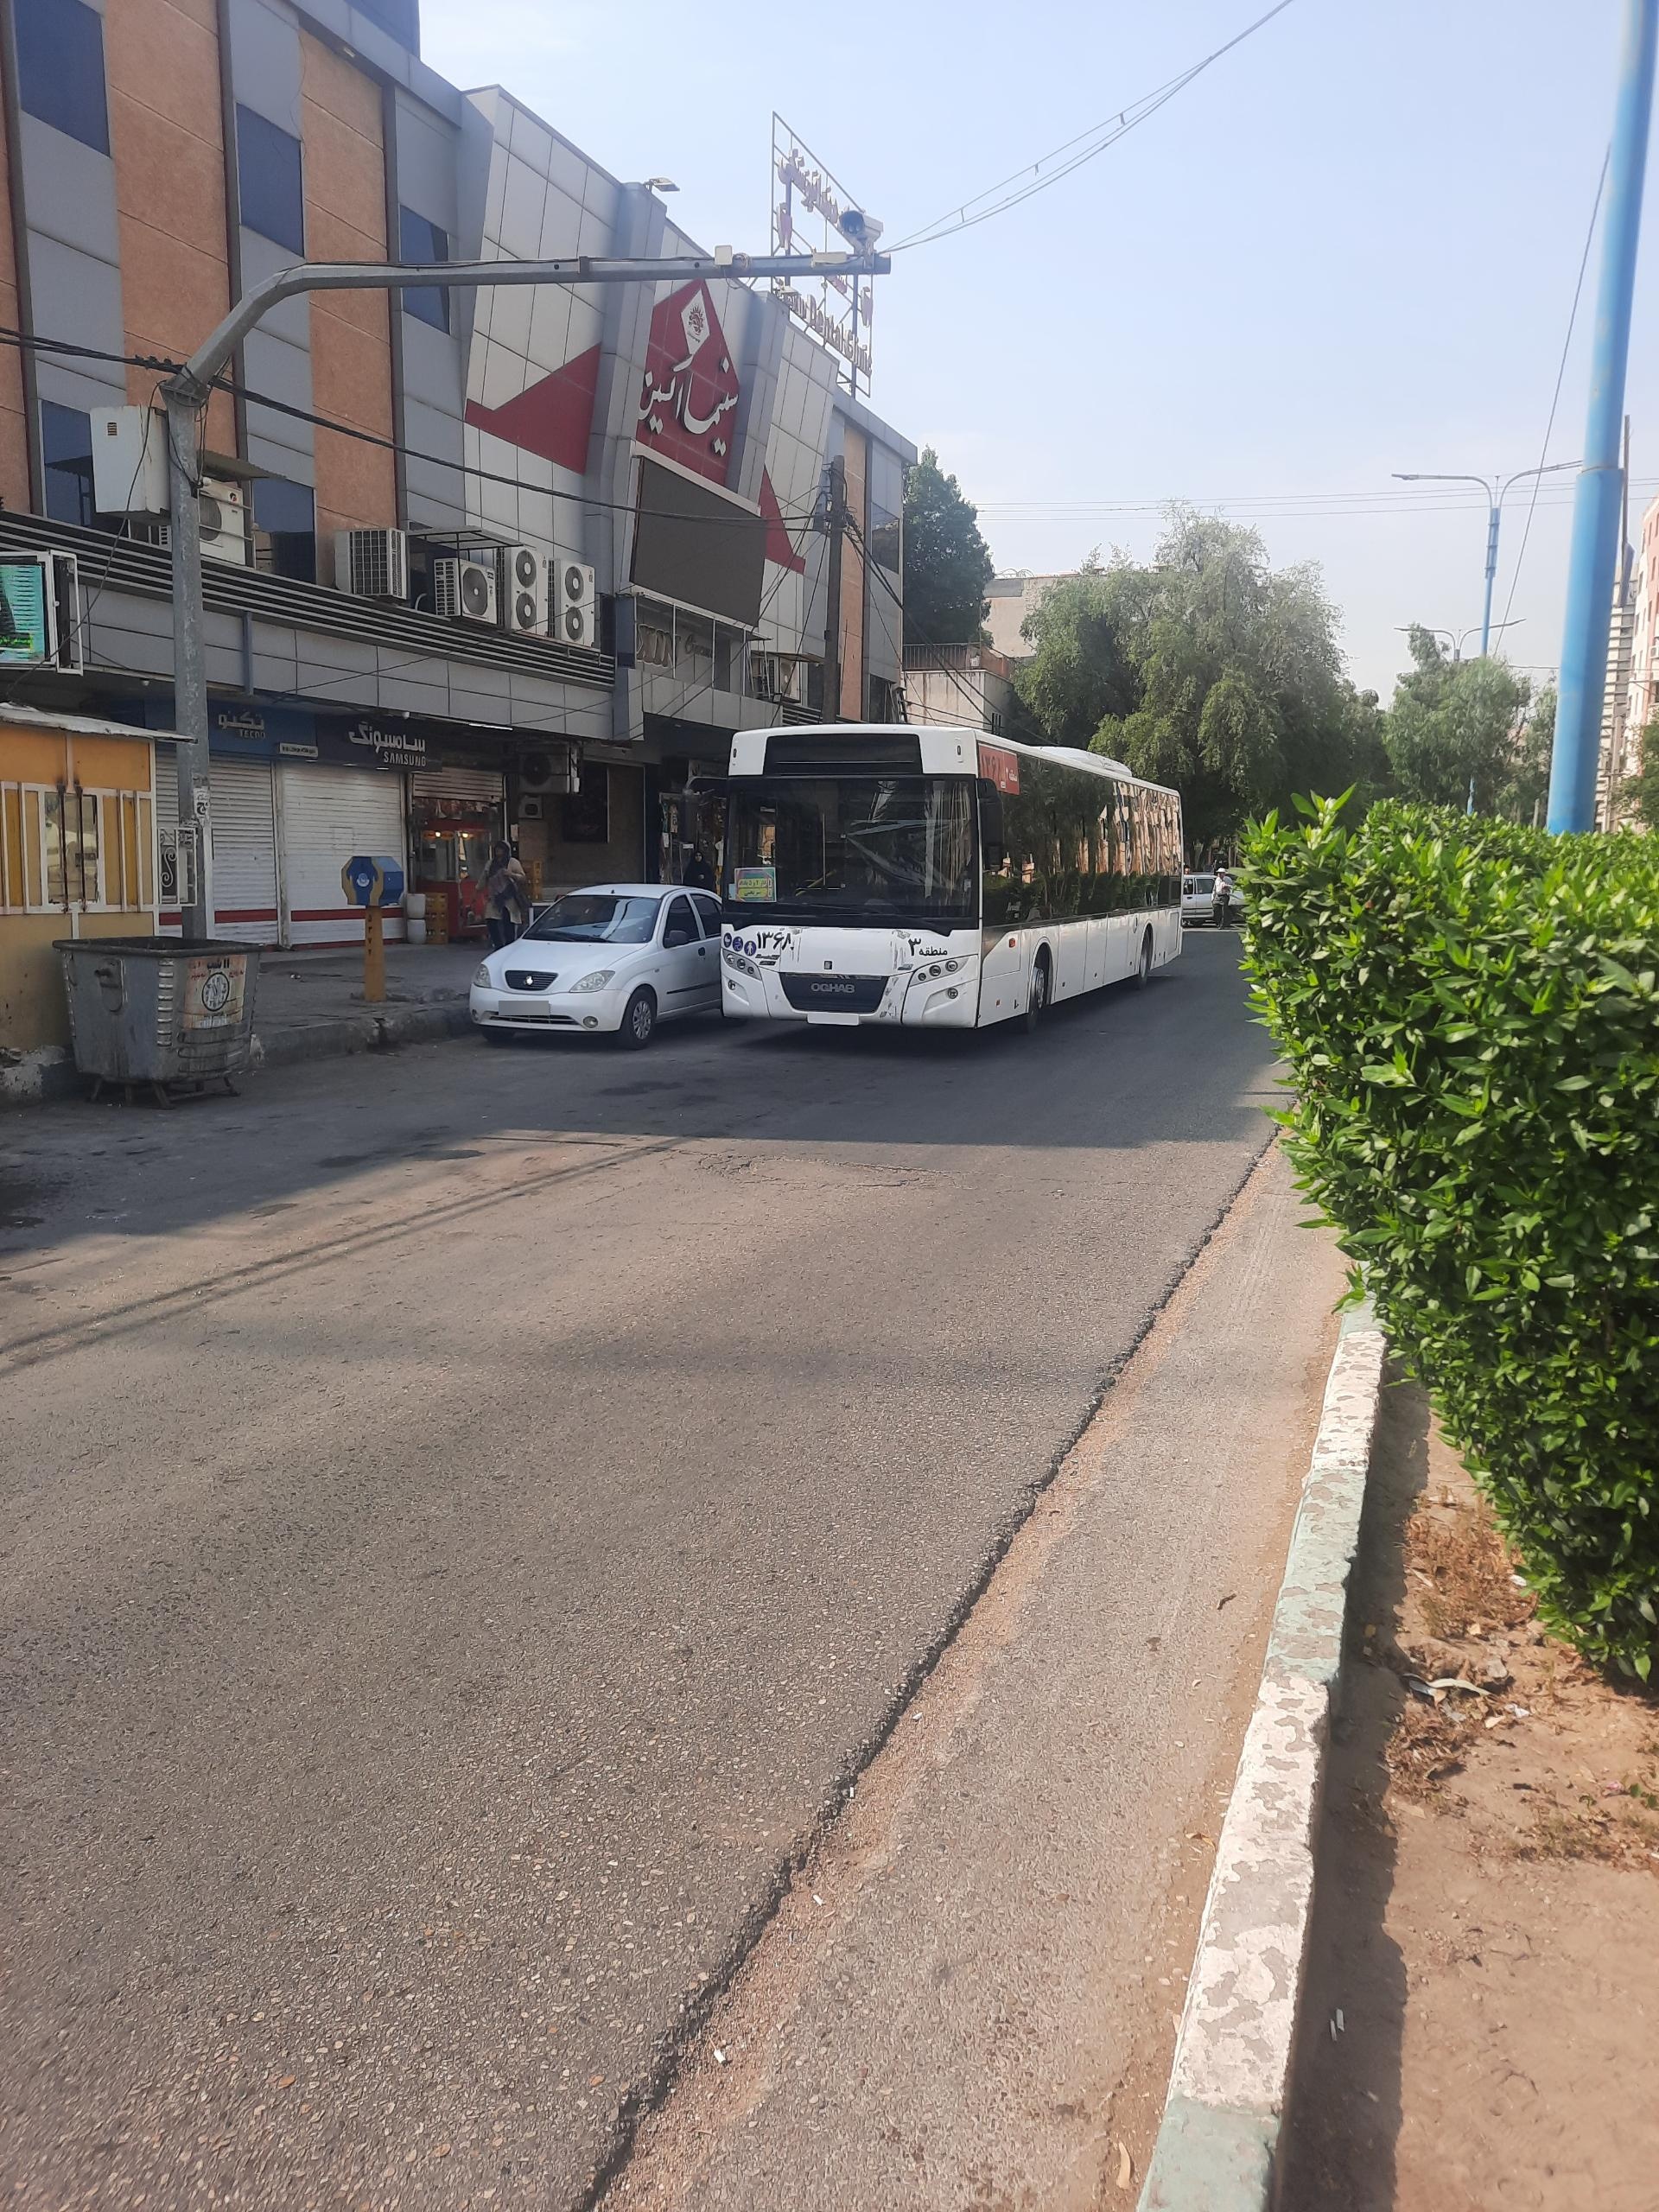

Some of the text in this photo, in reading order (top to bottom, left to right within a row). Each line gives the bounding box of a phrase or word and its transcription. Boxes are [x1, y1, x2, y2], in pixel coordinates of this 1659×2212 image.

[683, 357, 739, 456] سینما
[219, 710, 264, 730] تکنو
[348, 721, 426, 753] سامسونگ
[384, 751, 427, 767] SAMSUNG
[757, 931, 791, 950] ۱۳۶۸
[908, 938, 948, 957] منطقه ۳
[810, 982, 855, 994] OGHAB
